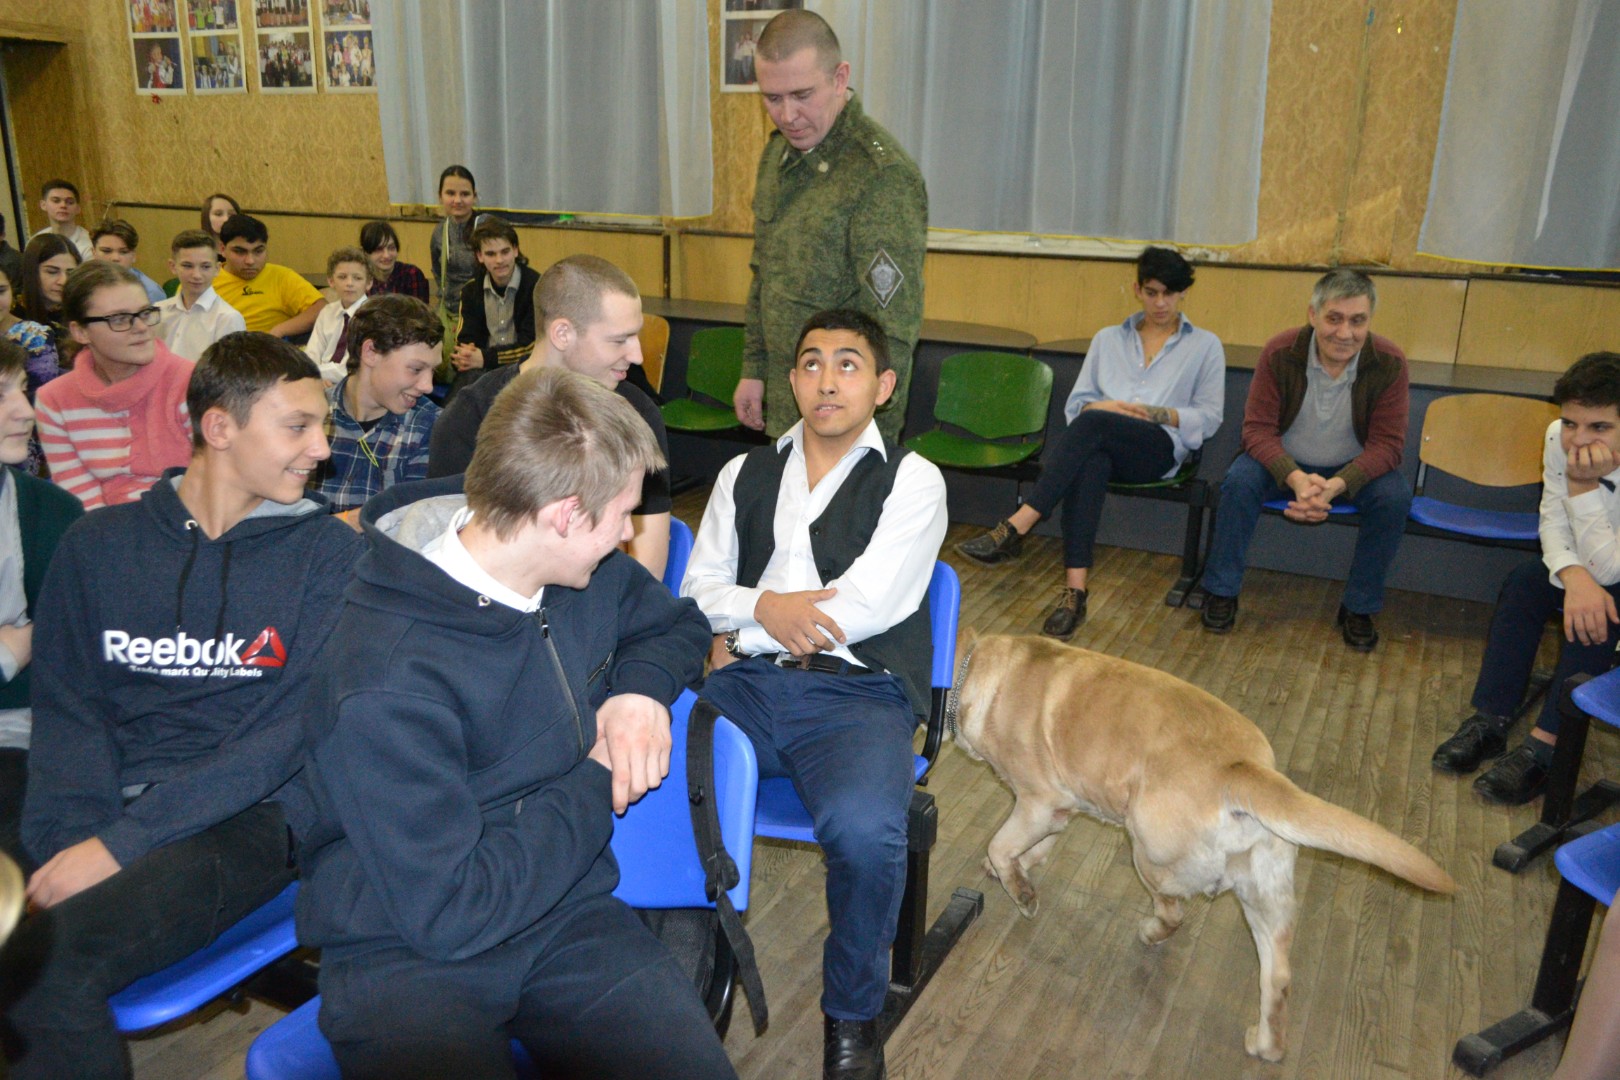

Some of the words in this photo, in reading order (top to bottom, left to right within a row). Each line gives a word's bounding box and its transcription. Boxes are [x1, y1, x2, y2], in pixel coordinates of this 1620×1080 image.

[103, 630, 246, 666] Reebok
[160, 667, 191, 676] mark
[230, 667, 263, 677] Labels
